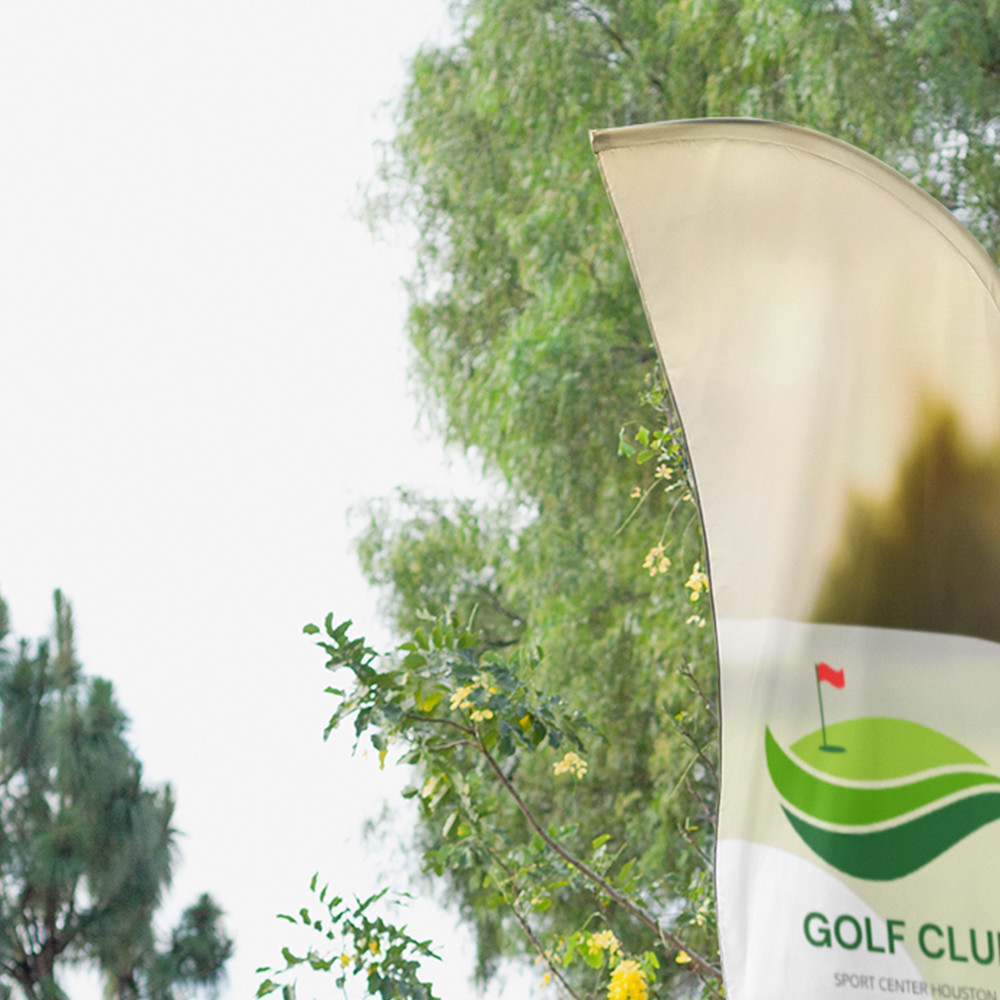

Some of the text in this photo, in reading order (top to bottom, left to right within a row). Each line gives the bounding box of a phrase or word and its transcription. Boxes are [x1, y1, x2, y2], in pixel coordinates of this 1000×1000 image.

[803, 911, 906, 955] GOLF
[833, 972, 875, 990] SPORT
[878, 976, 929, 996] CENTER
